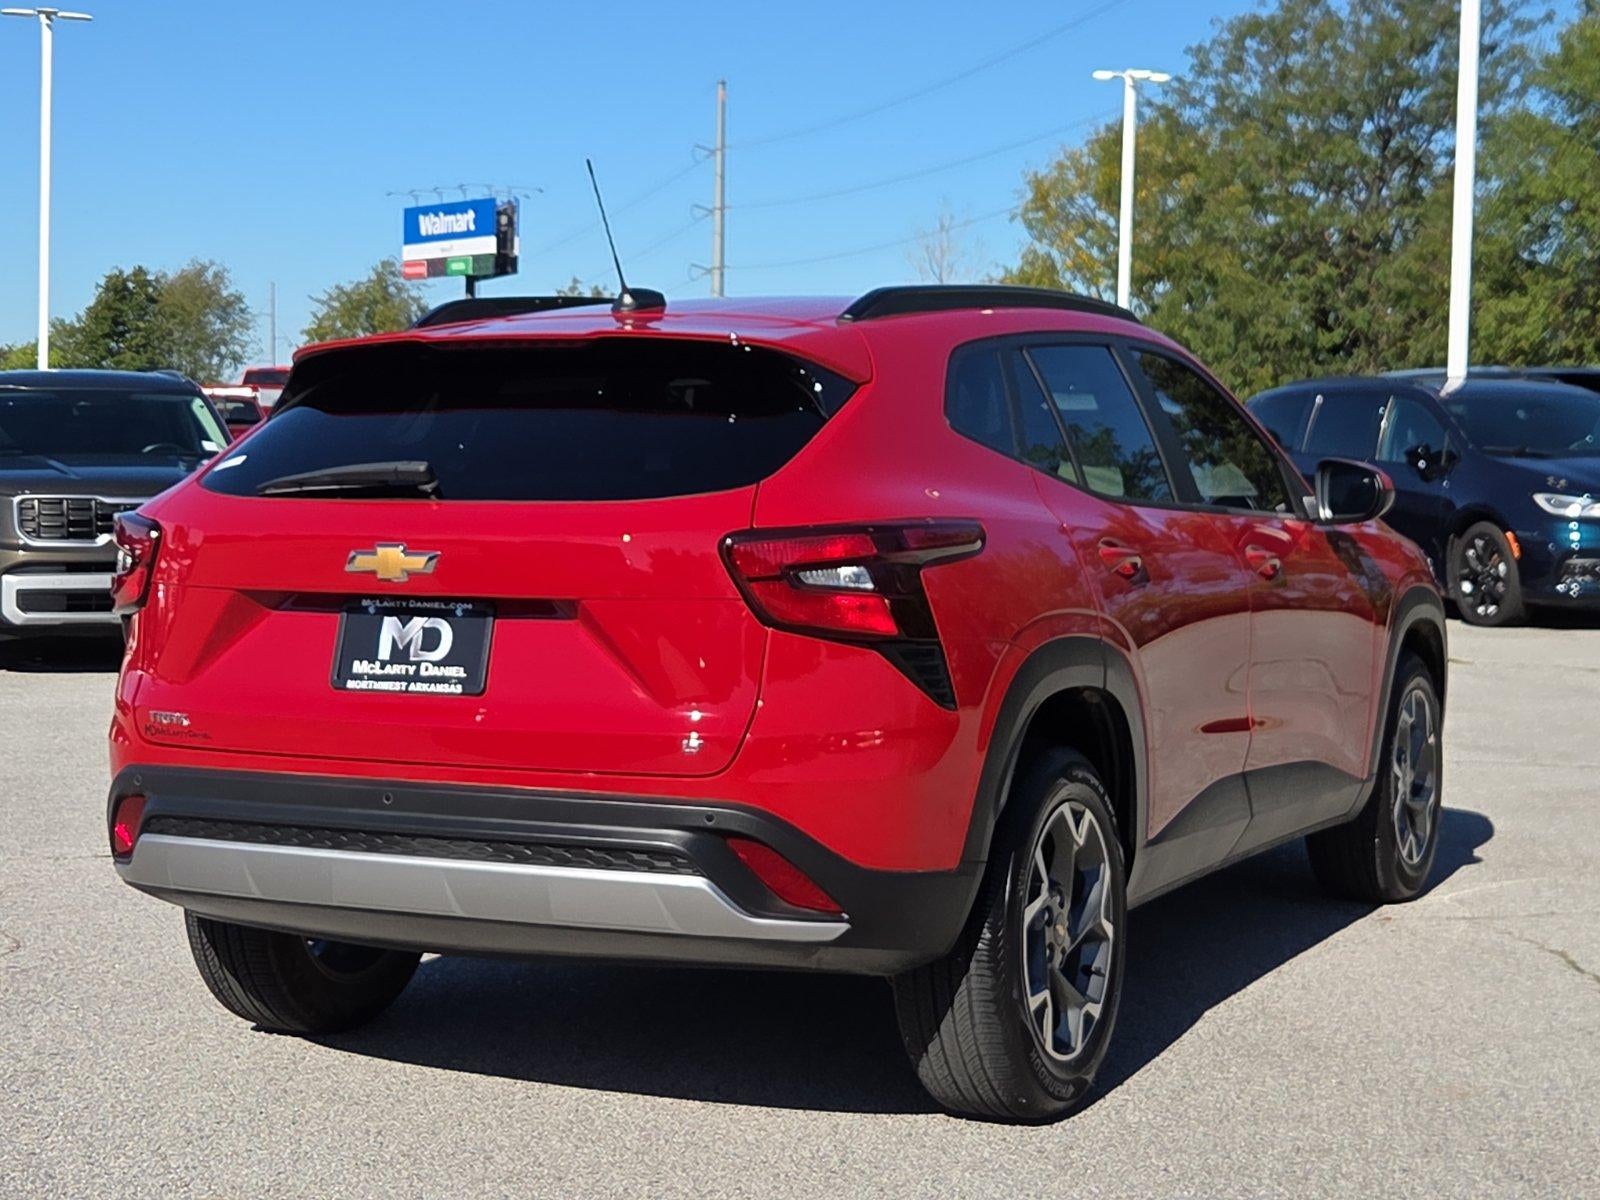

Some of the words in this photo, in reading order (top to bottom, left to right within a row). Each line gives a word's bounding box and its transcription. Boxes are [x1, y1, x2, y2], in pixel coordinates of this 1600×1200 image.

[418, 209, 476, 236] Walmart
[419, 661, 468, 678] DANIEL
[408, 682, 463, 694] ARKANSAS
